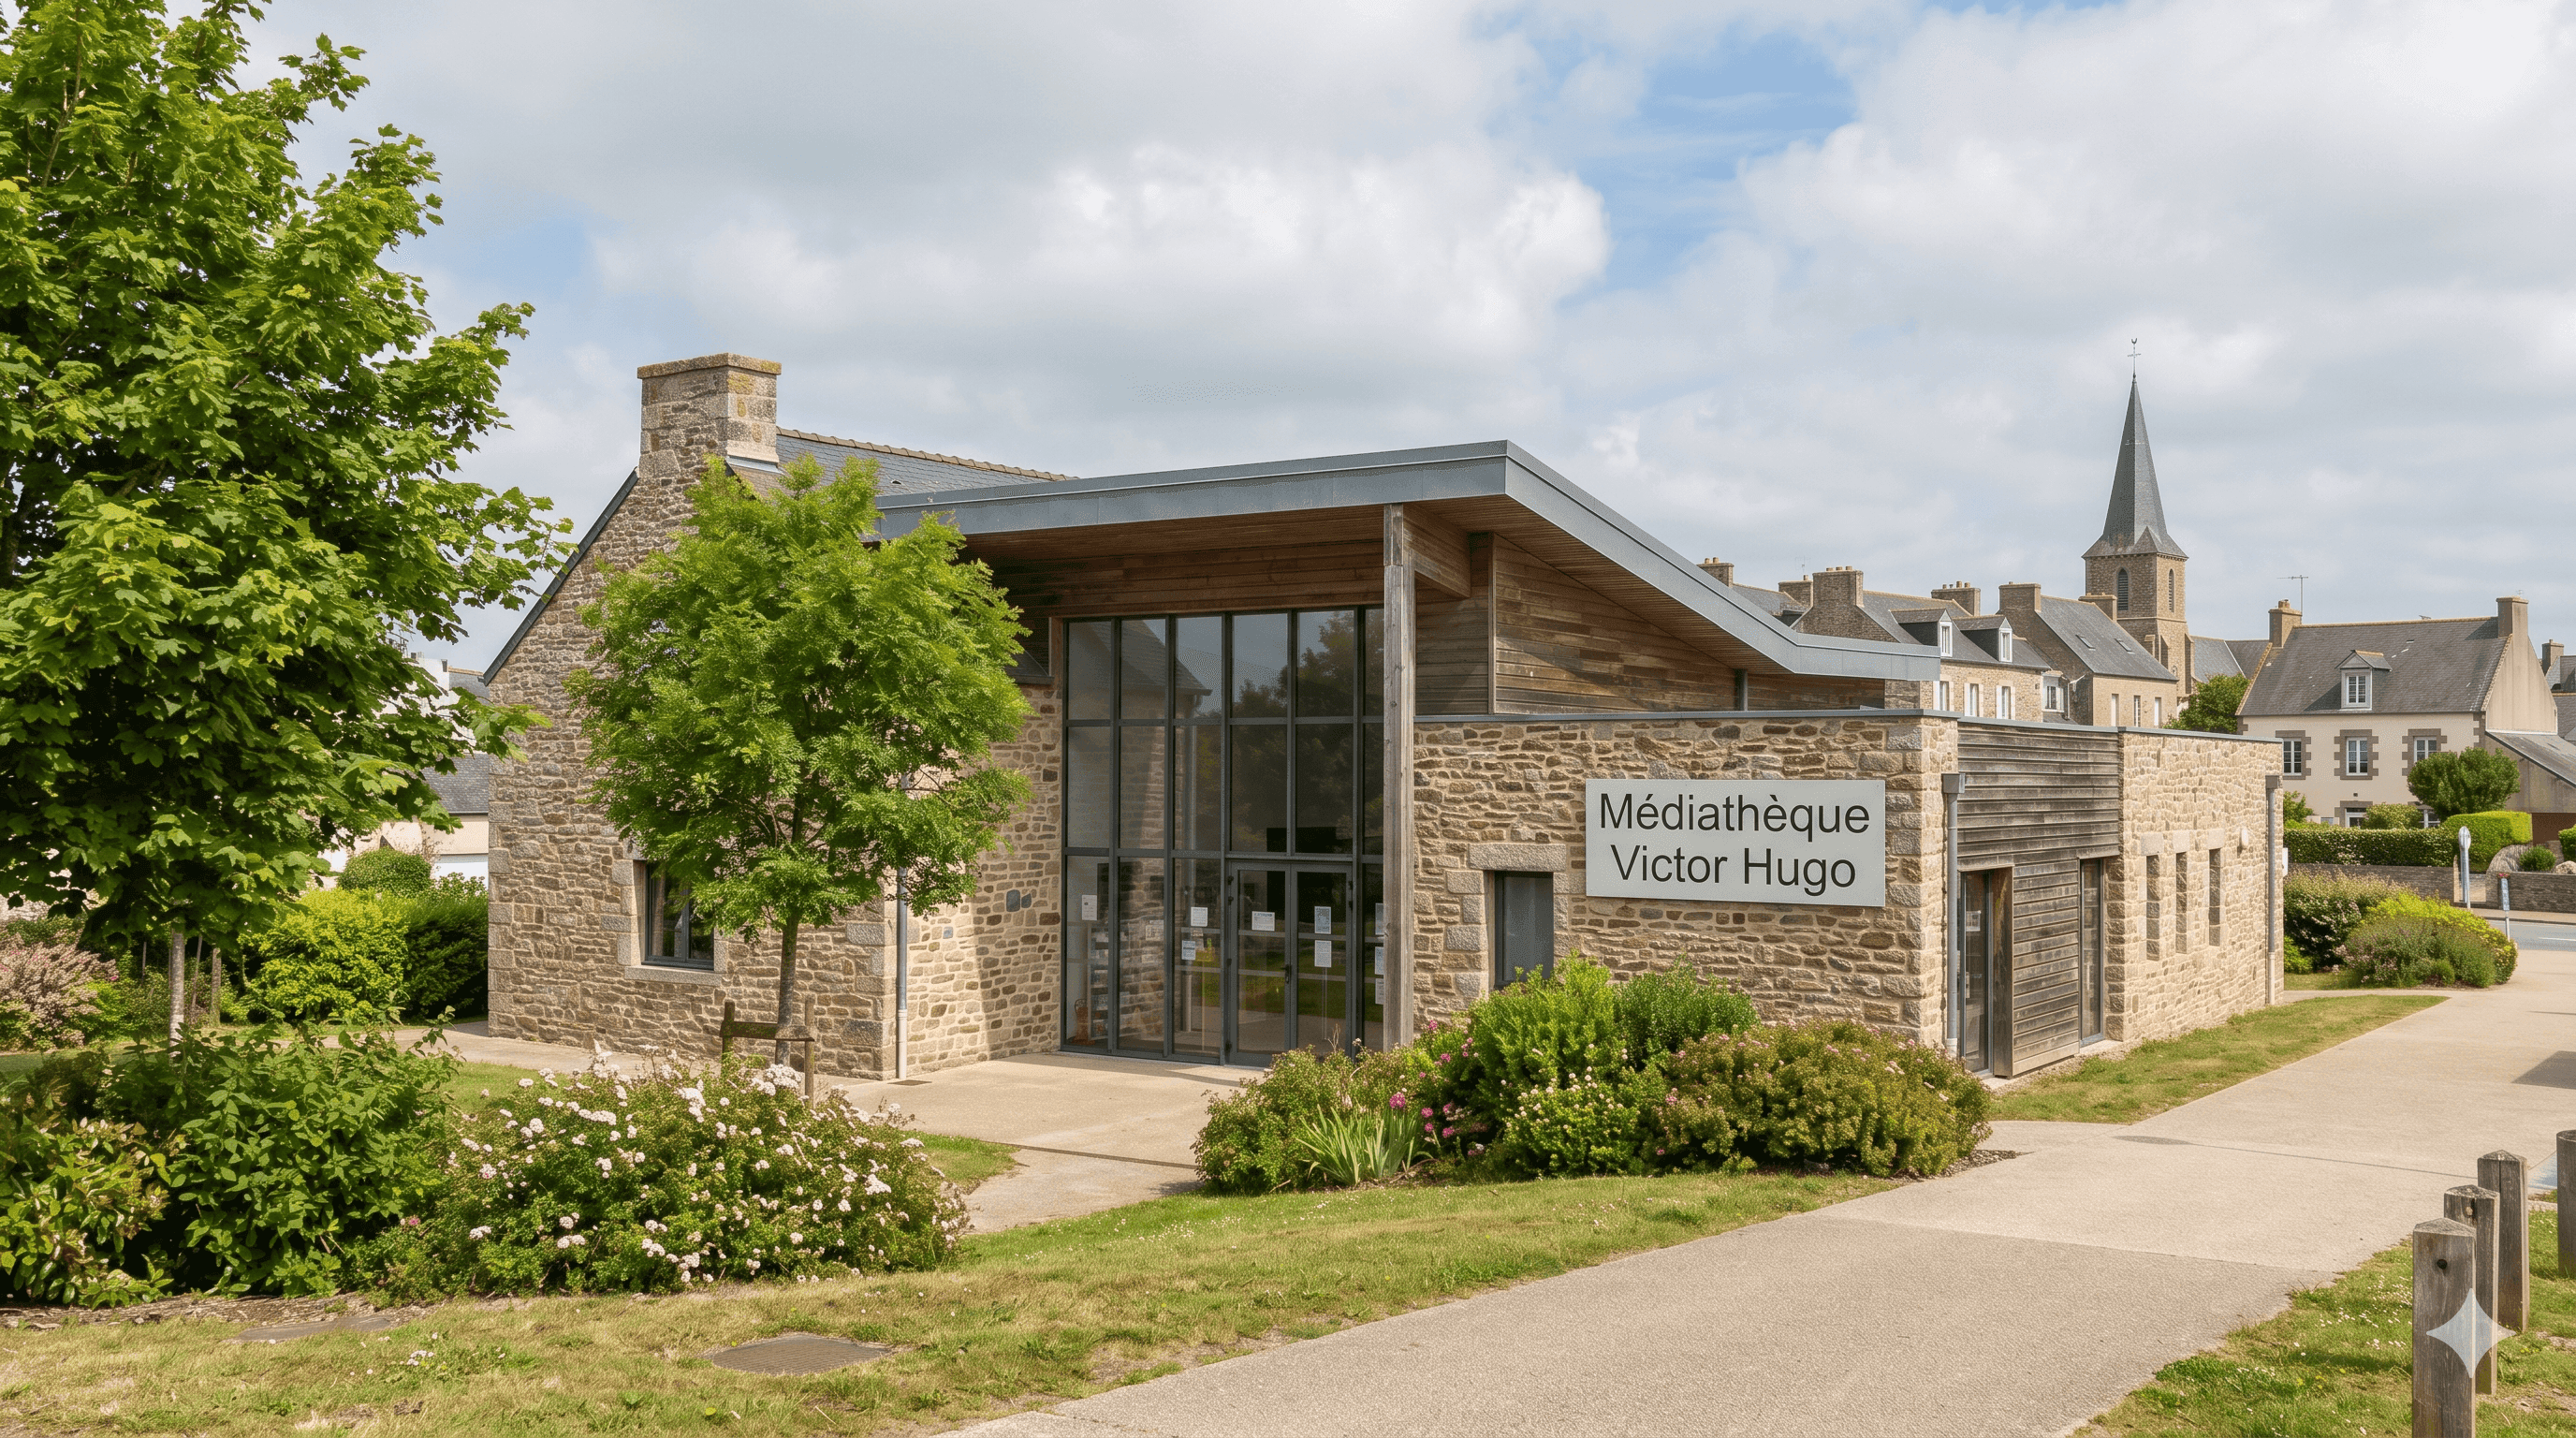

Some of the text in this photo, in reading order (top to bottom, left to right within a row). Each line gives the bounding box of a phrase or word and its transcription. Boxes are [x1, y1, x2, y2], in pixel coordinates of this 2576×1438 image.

[1600, 793, 1870, 843] Médiathèque
[1610, 844, 1856, 896] Victor Hugo
